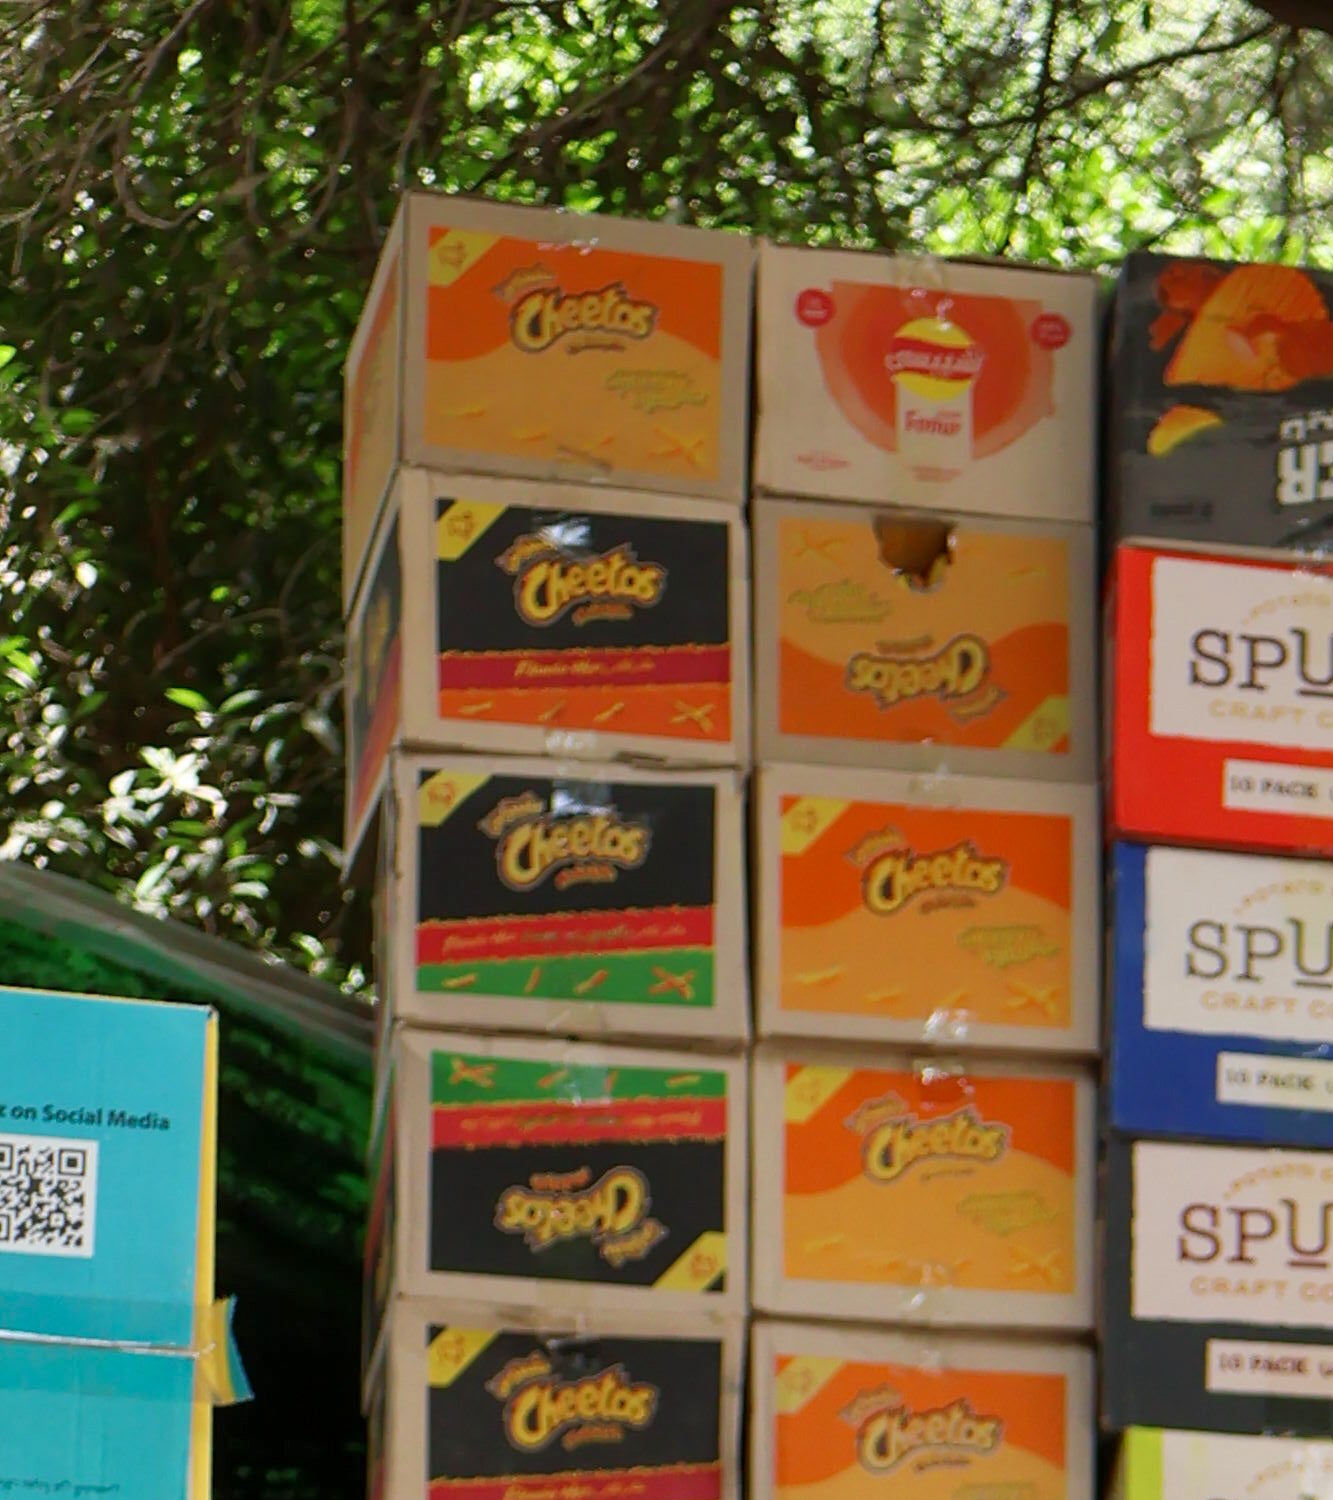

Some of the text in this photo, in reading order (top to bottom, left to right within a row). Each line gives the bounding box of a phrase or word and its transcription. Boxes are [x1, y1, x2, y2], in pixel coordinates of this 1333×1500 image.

[511, 285, 657, 352] Cheetos
[514, 546, 666, 626] Cheetos
[845, 634, 990, 704] Cheetos
[1208, 699, 1310, 728] CRAFT
[497, 814, 650, 890] Cheetos
[862, 842, 1009, 915] Cheetos
[1201, 990, 1303, 1018] CRAFT
[11, 1103, 171, 1131] on Social Media
[862, 1107, 1012, 1183] Cheetos
[496, 1165, 650, 1250] Cheetos
[1190, 1274, 1292, 1300] CRAFT
[504, 1364, 658, 1451] Cheetos
[857, 1401, 1003, 1473] Cheetos
